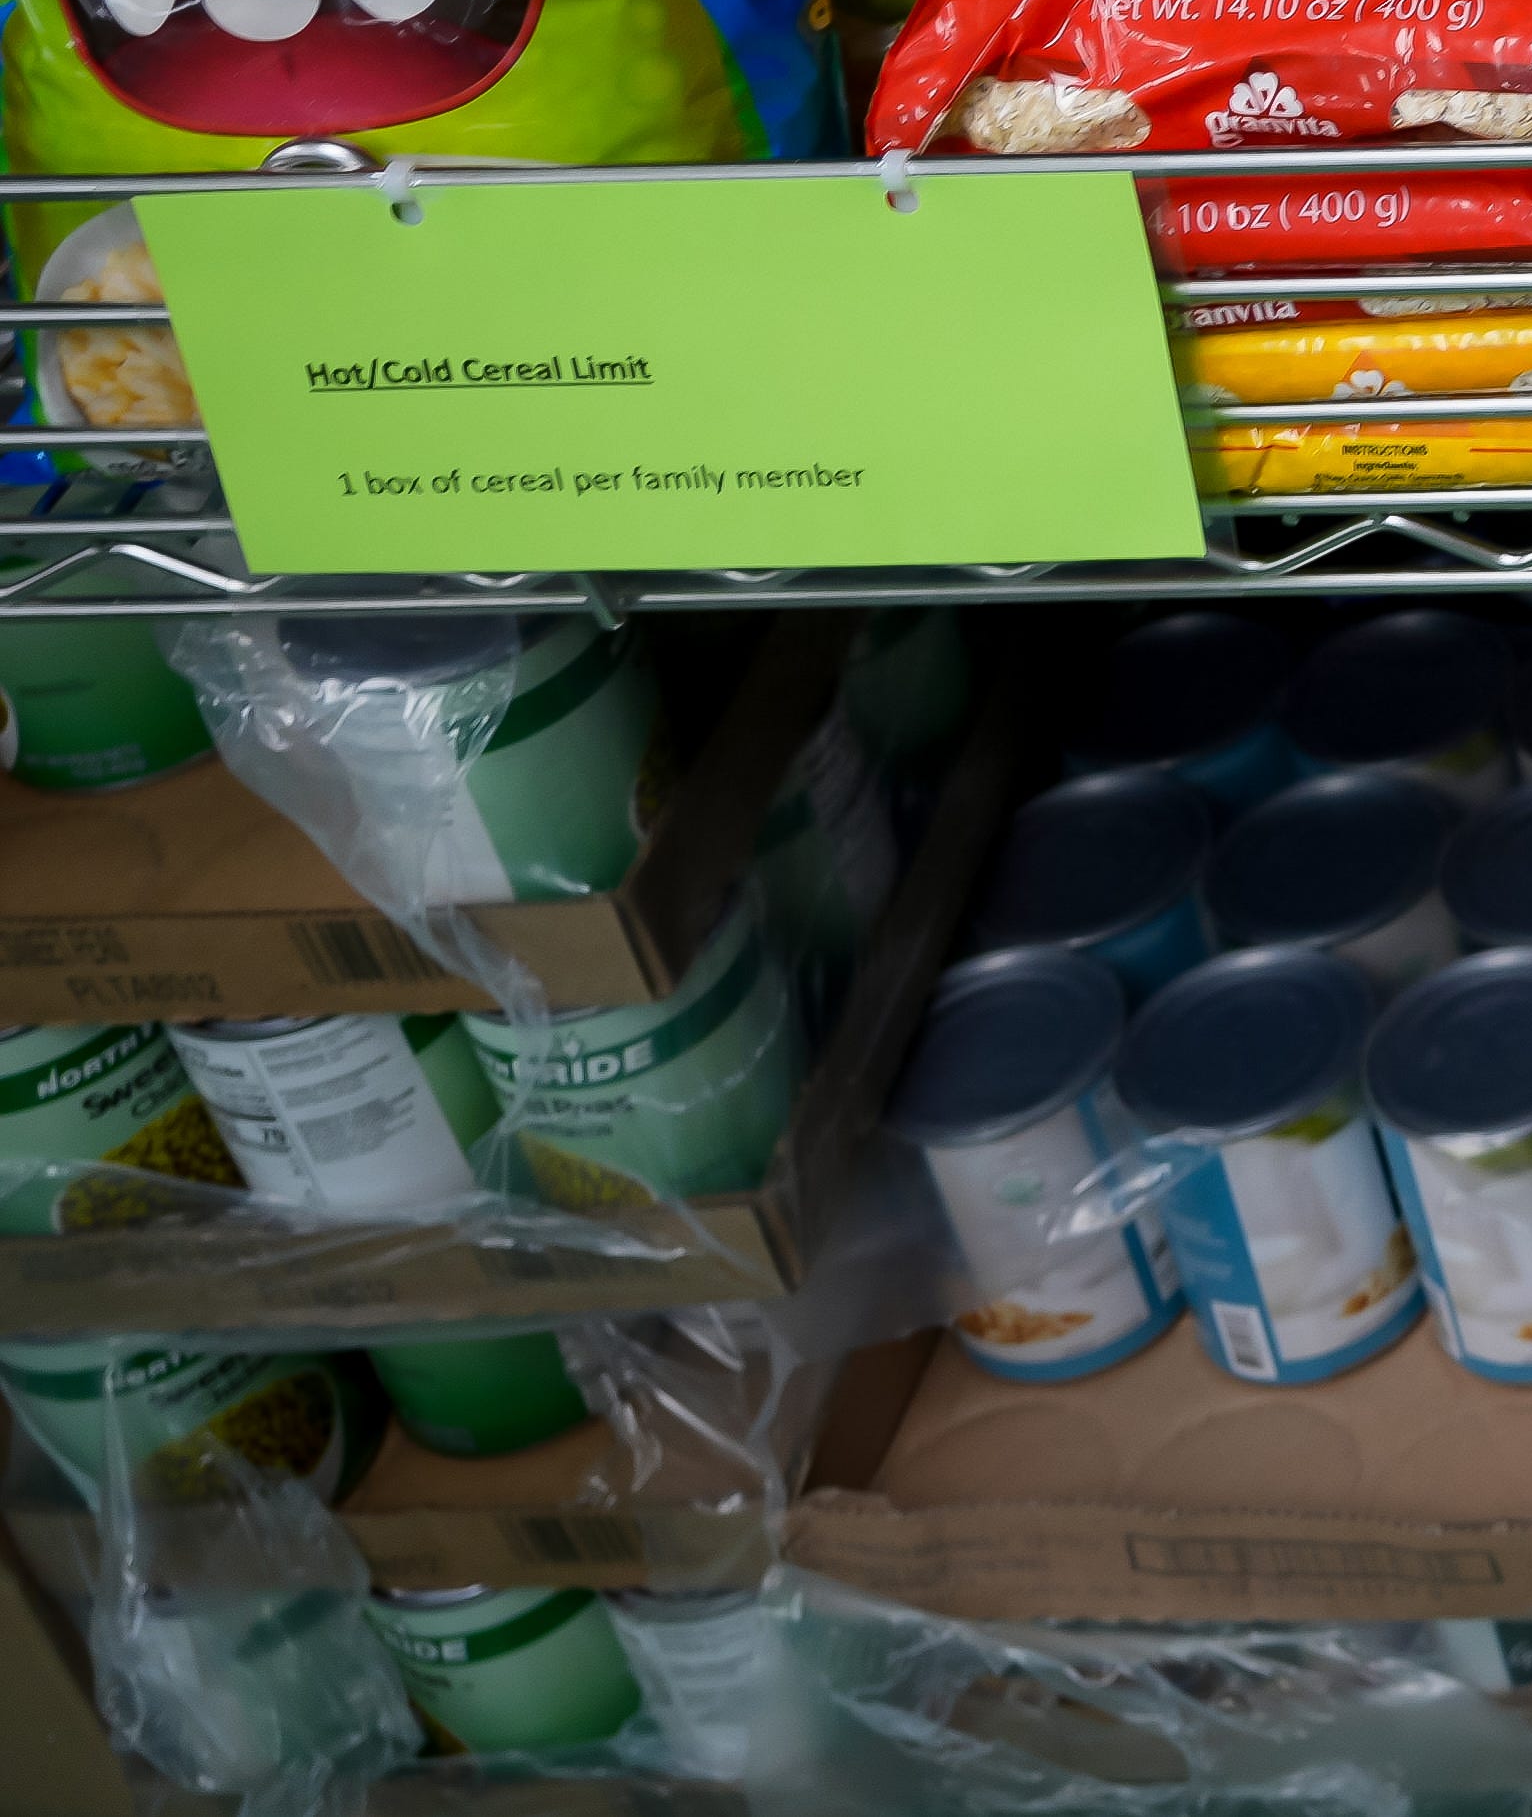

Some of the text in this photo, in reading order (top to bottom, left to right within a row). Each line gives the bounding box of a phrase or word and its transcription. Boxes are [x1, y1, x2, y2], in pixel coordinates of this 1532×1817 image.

[1204, 111, 1343, 149] granvita
[304, 353, 652, 389] Hot/Cold Cereal Limit
[339, 463, 867, 498] 1 box of cereal per family member
